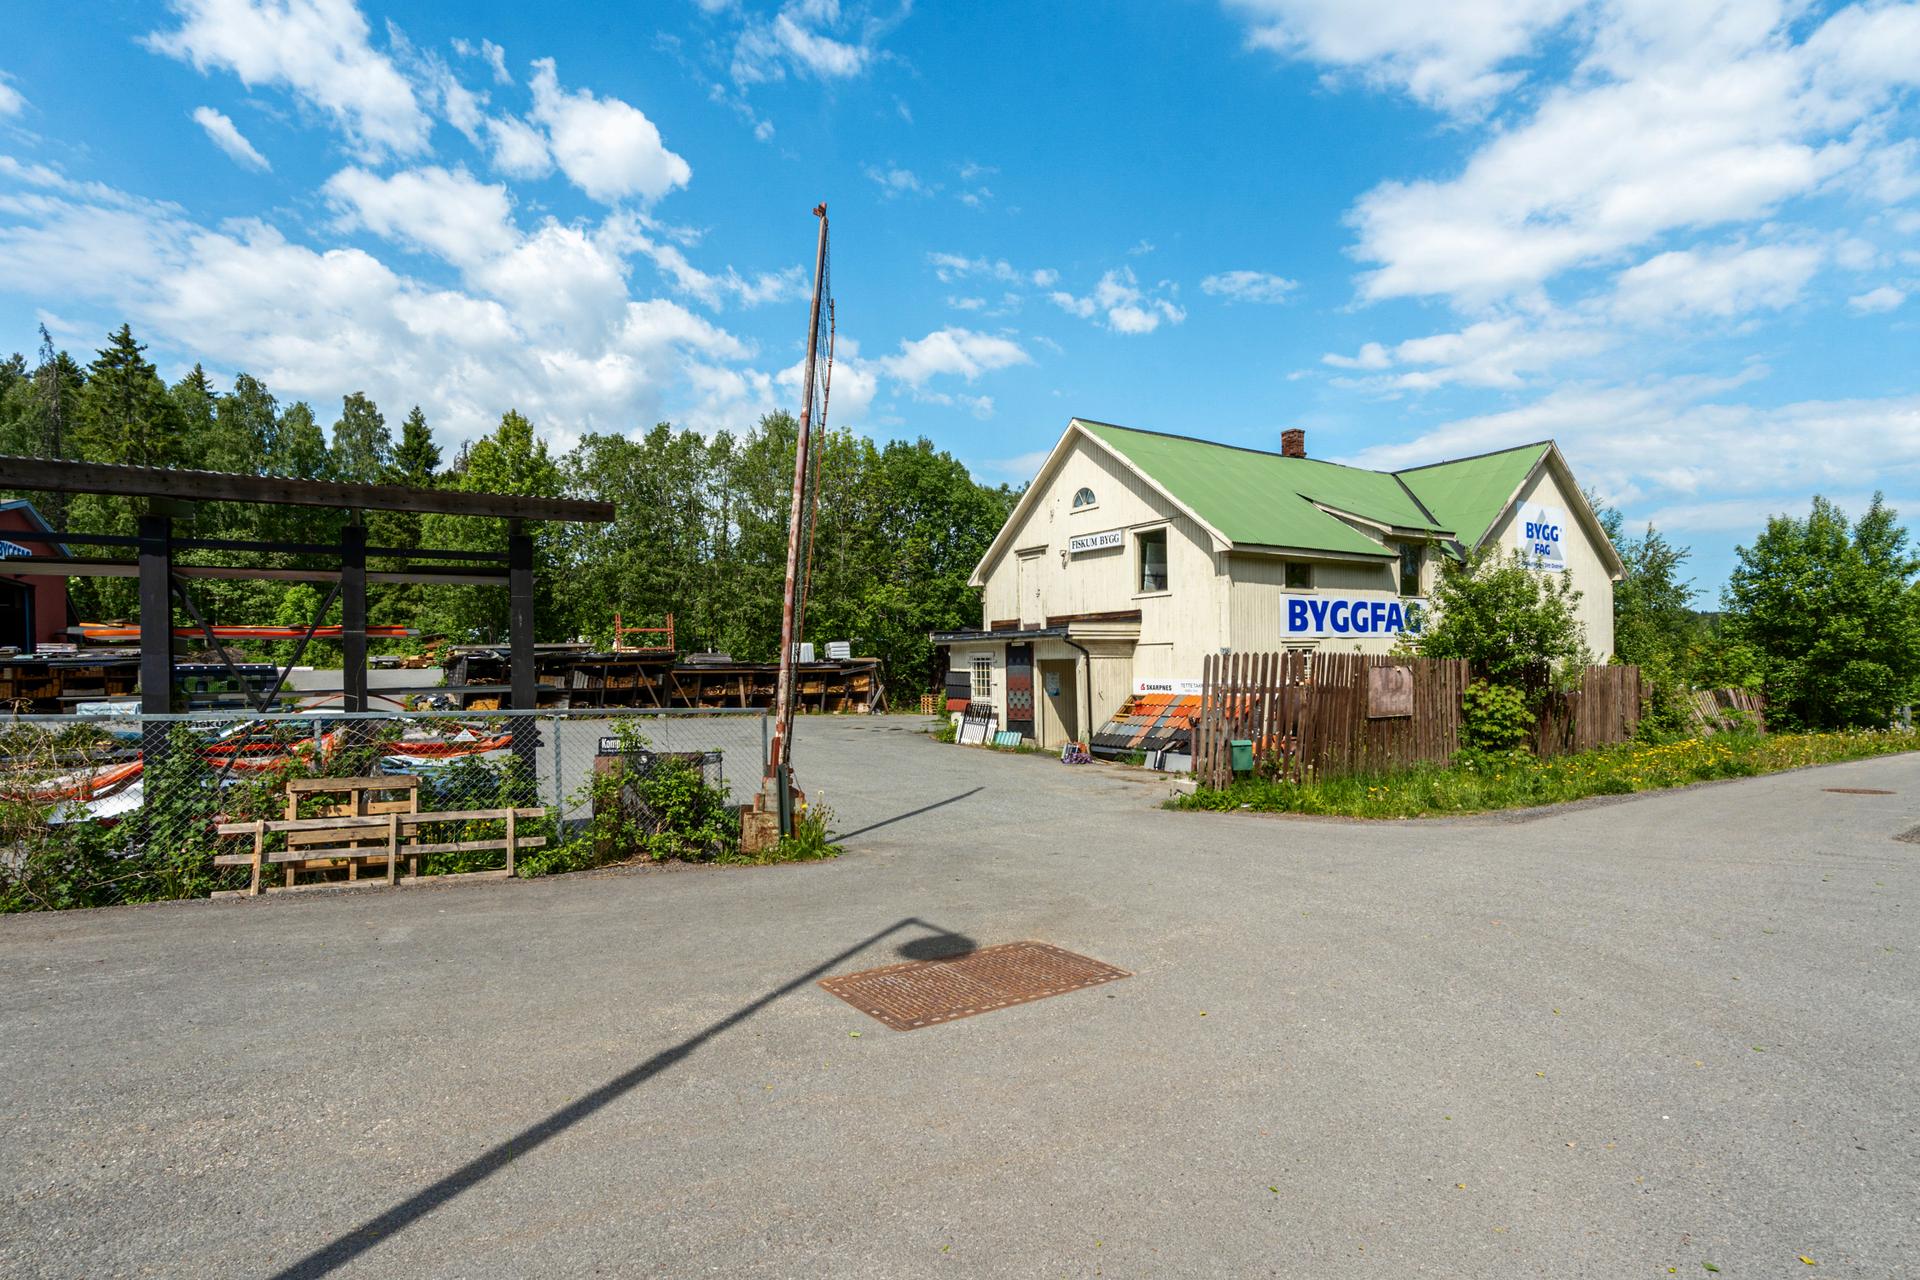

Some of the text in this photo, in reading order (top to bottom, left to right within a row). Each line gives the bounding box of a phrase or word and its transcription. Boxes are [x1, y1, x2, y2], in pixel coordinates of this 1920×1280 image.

[1526, 522, 1559, 542] BYGG
[1071, 533, 1120, 550] FISKUM BYGG
[1534, 543, 1551, 556] FAG
[1288, 600, 1422, 634] BYGGFAG
